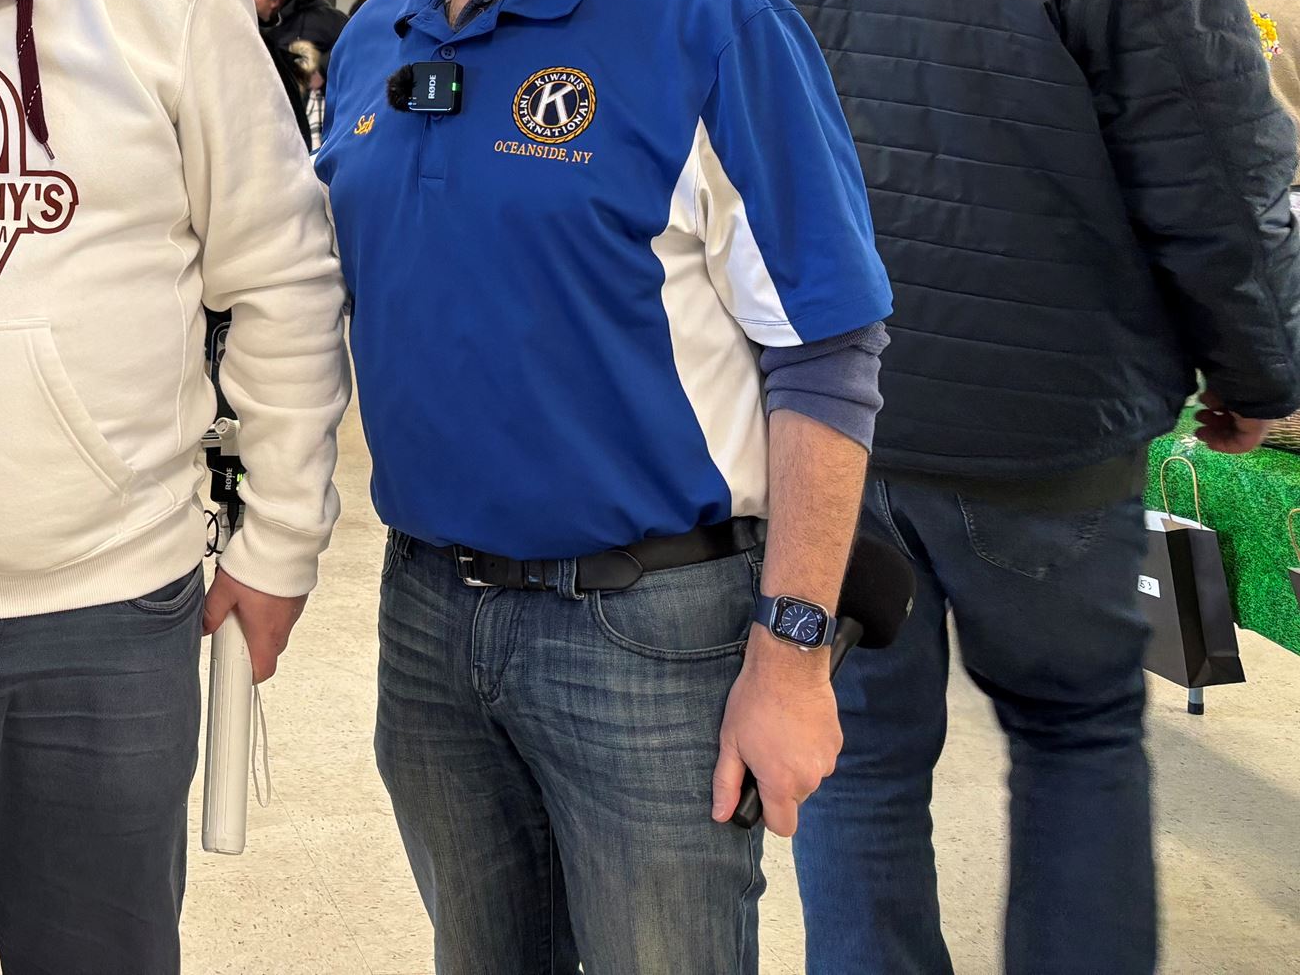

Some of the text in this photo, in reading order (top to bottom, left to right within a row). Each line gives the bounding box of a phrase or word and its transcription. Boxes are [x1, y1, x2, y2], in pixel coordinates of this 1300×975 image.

[534, 73, 585, 91] KIWANIS
[519, 94, 589, 136] INTERNATIONAL
[536, 83, 574, 124] K
[494, 139, 593, 164] OCEANSIDE, NY
